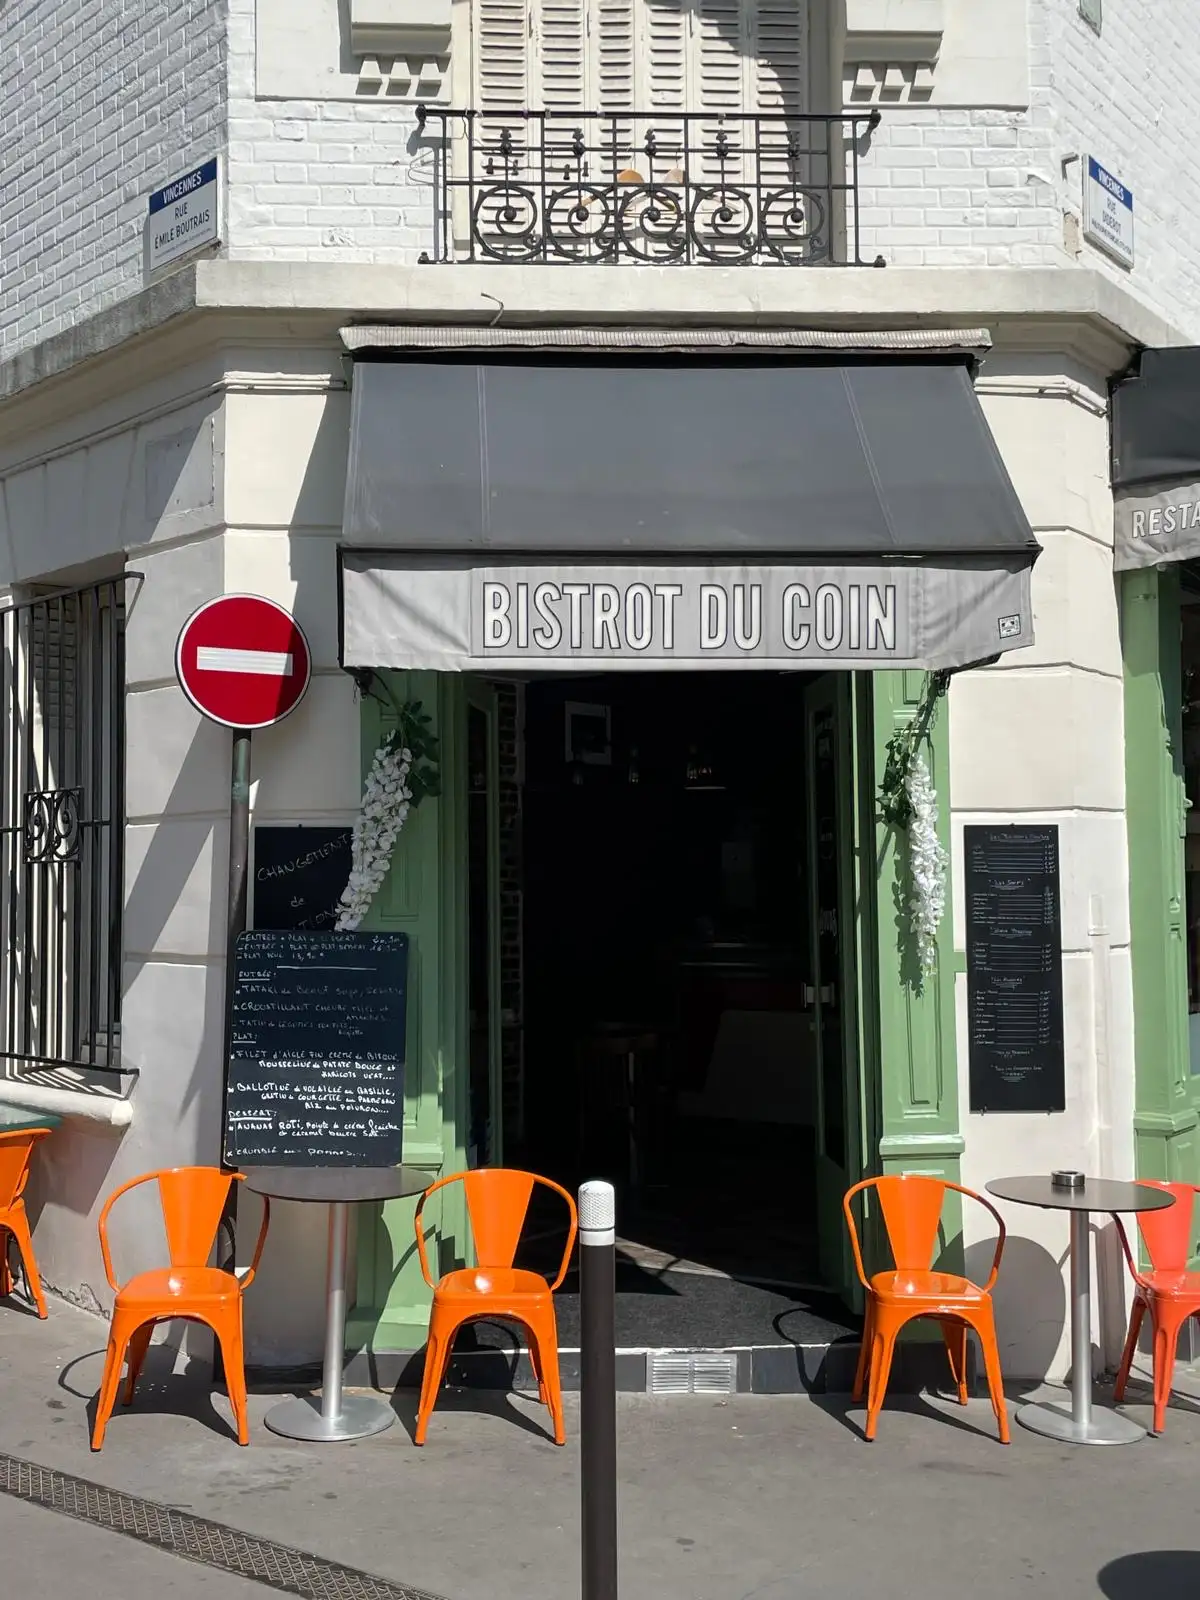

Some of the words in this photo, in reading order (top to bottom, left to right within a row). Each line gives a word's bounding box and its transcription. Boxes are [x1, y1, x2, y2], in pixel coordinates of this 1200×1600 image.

[162, 170, 202, 205] VINCENNES
[1097, 167, 1125, 202] VINCENNES
[174, 202, 188, 220] RUE
[154, 227, 175, 250] ÉMILE
[176, 208, 210, 238] BOUTRAIS
[482, 581, 683, 651] BISTROT
[699, 582, 762, 651] DU
[782, 582, 897, 651] COIN
[236, 1050, 268, 1059] FILET
[322, 1060, 352, 1069] PATATE
[355, 1061, 382, 1071] DOUCE
[237, 1082, 290, 1092] BALLOTINE
[303, 1084, 342, 1094] VOLAILLE
[298, 1094, 342, 1102] COURGETTE
[237, 1122, 273, 1130] ANANAS
